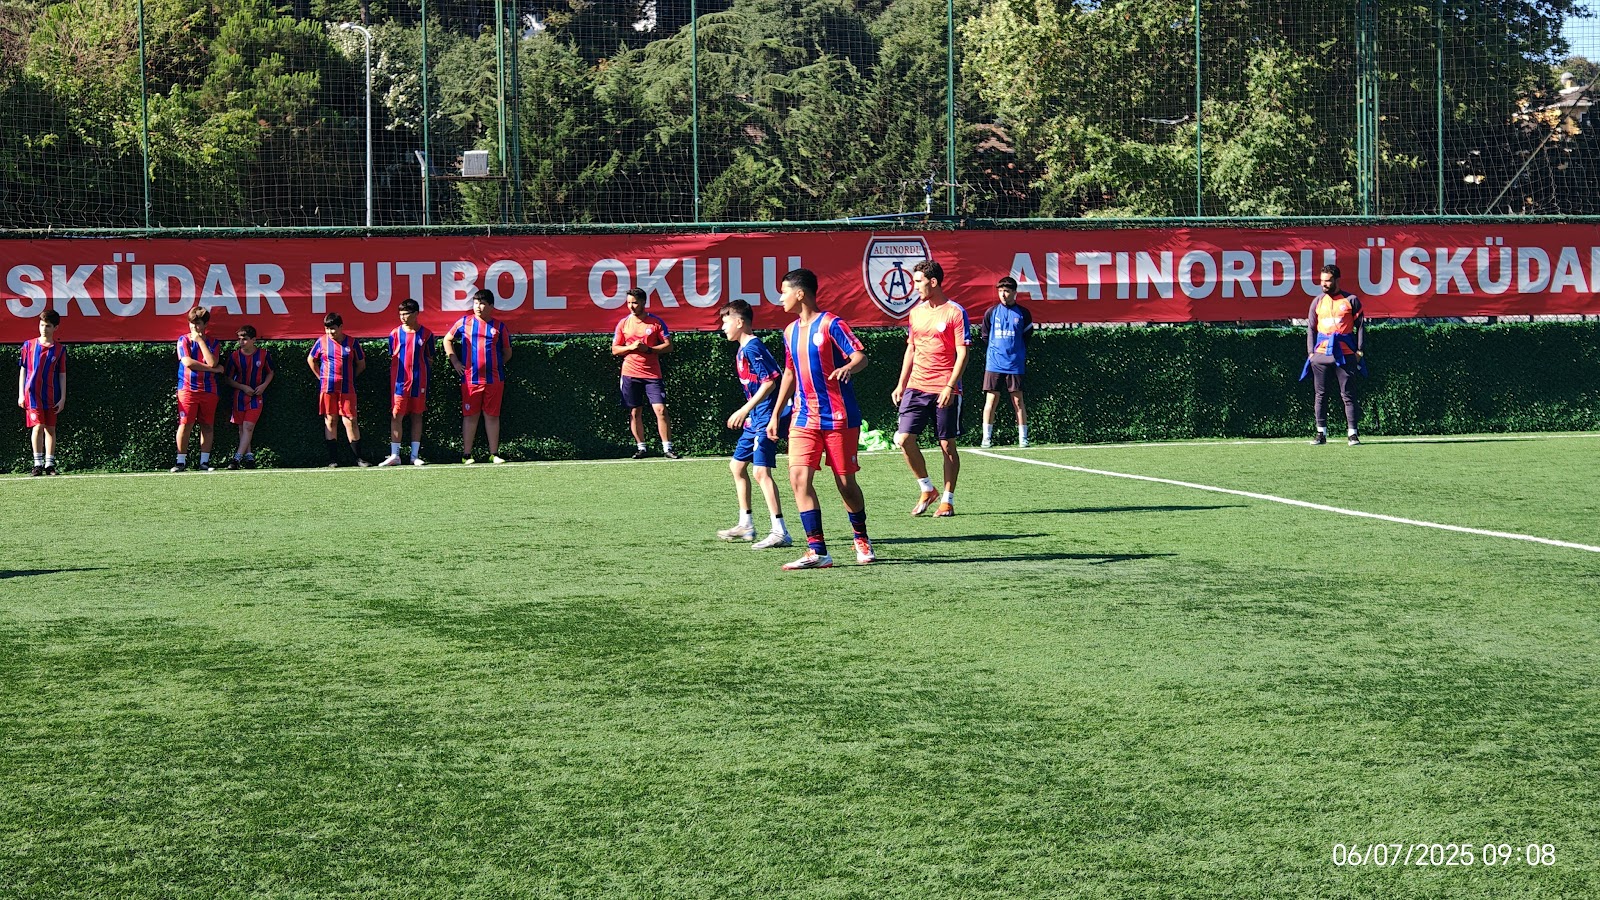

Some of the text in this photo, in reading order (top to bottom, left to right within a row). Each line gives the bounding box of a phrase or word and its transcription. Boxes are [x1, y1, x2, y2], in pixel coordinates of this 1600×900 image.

[873, 245, 921, 254] ALTINORDU
[1009, 236, 1600, 301] ALTINORDU ÜSKÜDA
[6, 252, 802, 319] SKÜDAR FUTBOL OKULU
